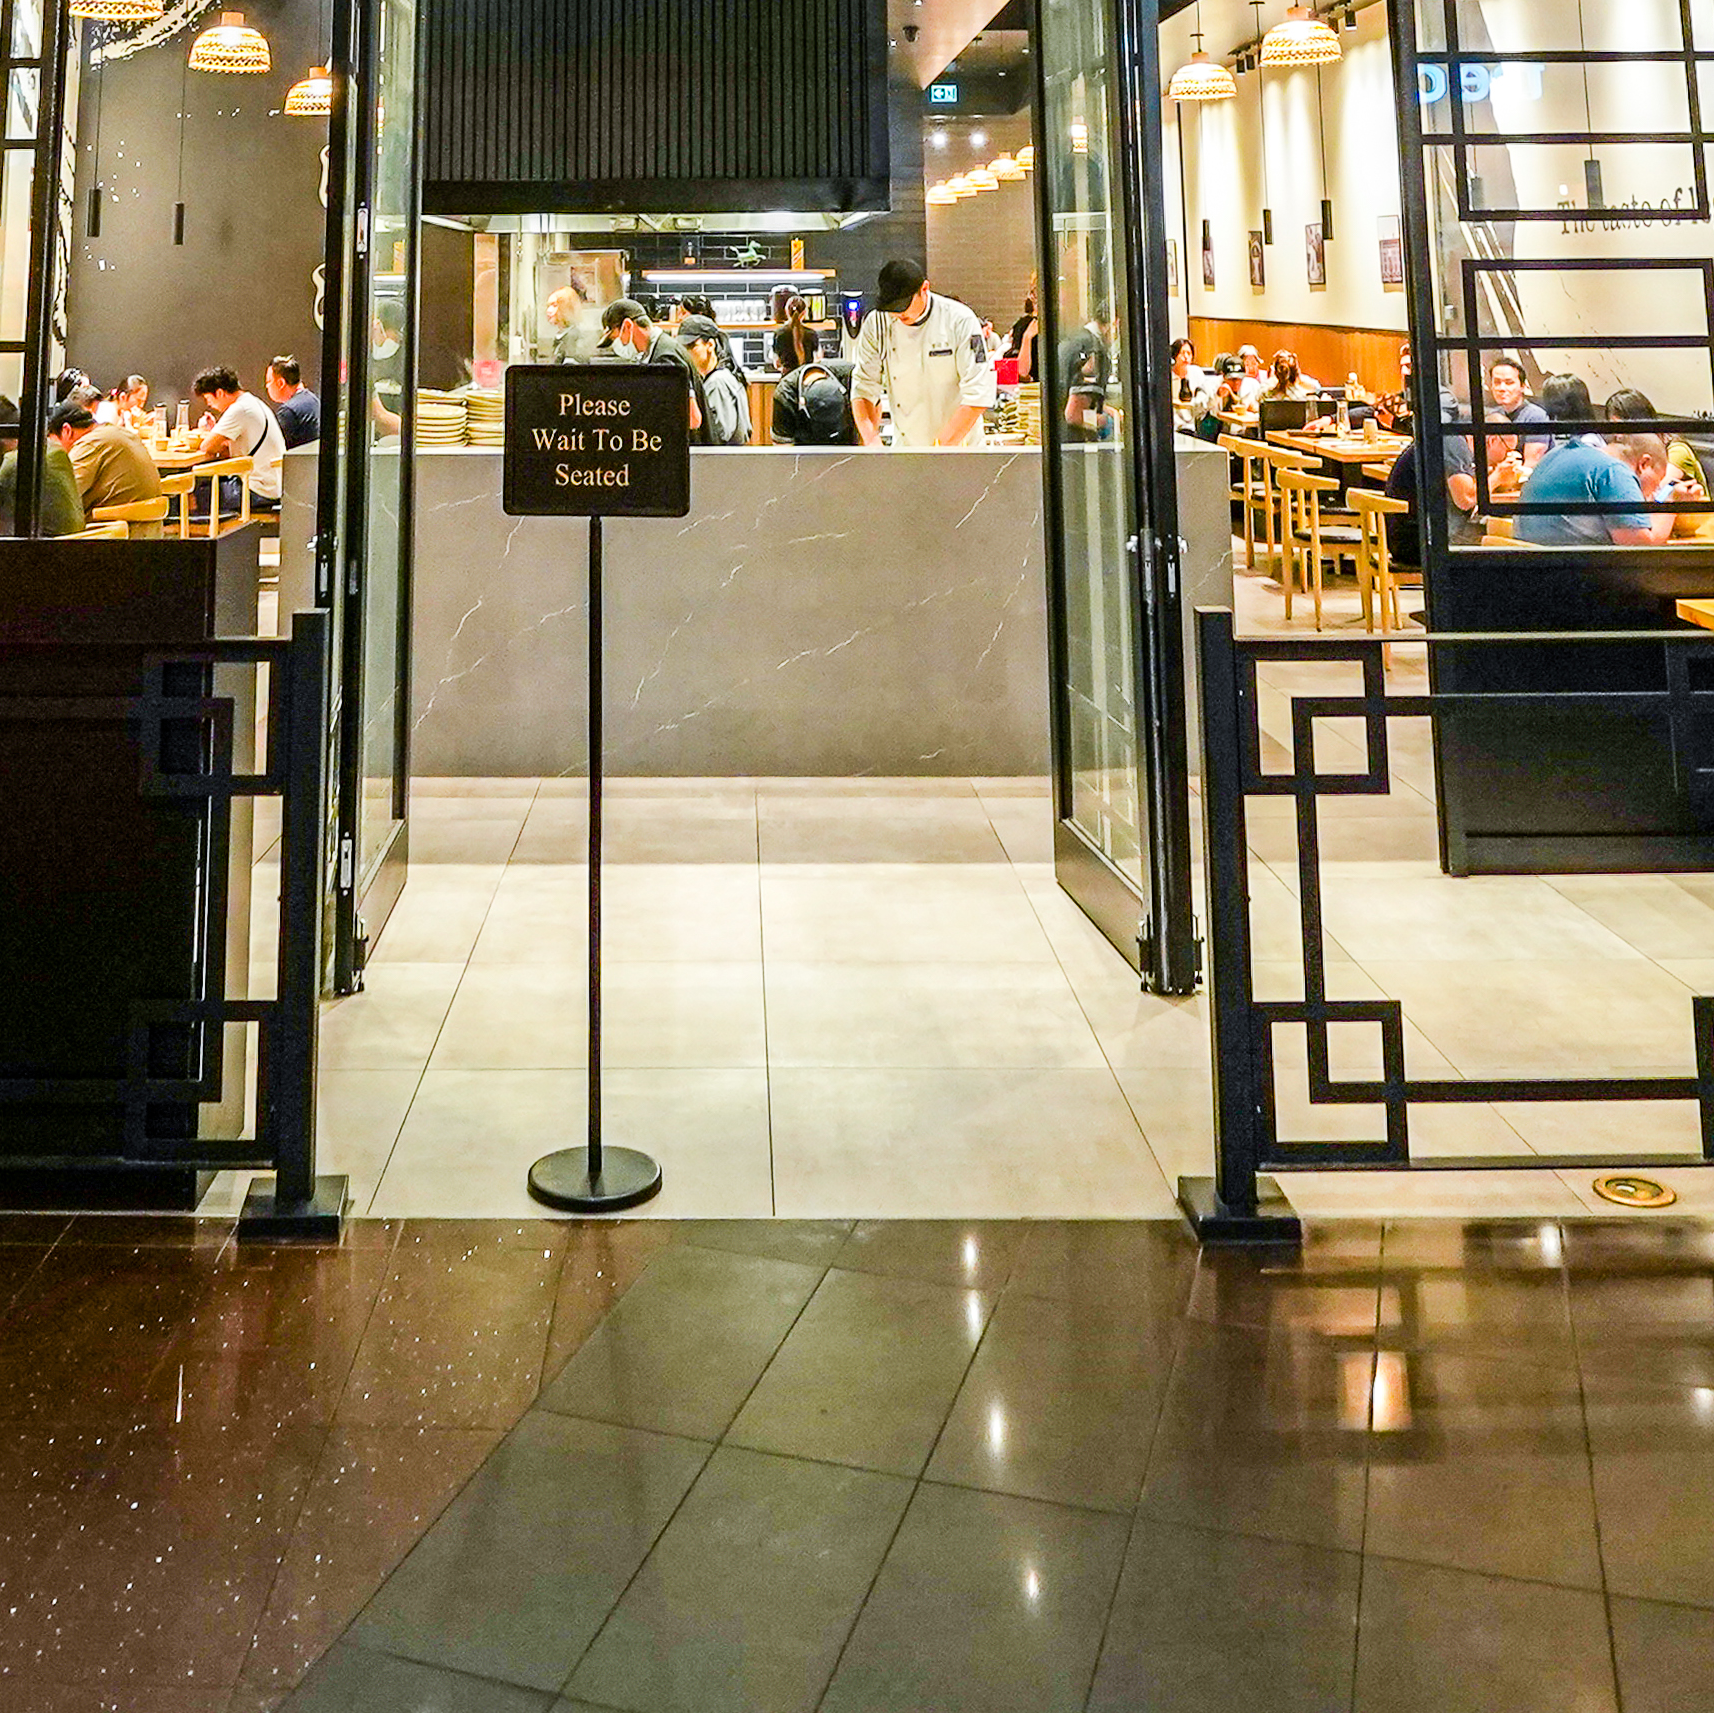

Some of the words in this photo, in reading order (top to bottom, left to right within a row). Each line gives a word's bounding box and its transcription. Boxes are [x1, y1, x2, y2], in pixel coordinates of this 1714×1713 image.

[559, 393, 630, 416] Please
[532, 428, 585, 451] Wait
[592, 428, 623, 451] To
[631, 428, 662, 451] Be
[555, 463, 630, 486] Seated
